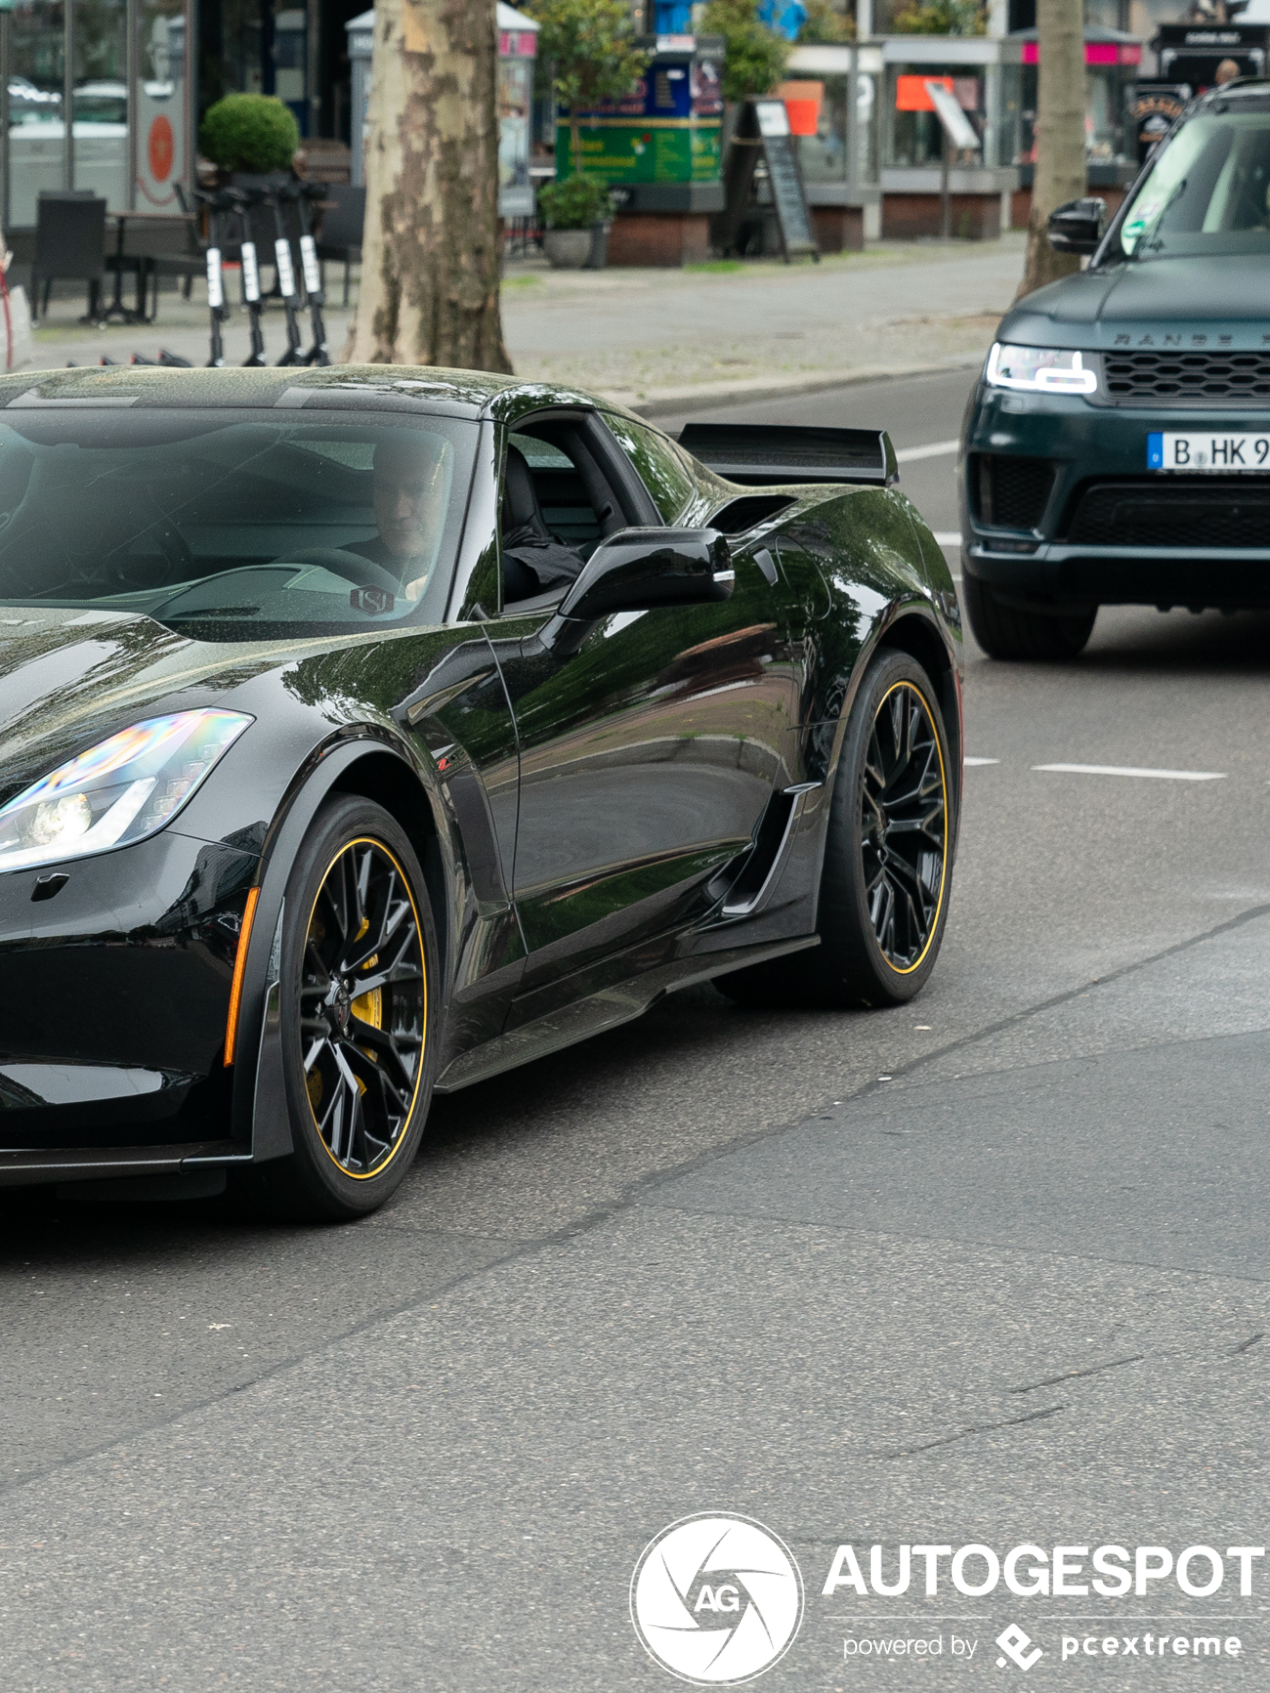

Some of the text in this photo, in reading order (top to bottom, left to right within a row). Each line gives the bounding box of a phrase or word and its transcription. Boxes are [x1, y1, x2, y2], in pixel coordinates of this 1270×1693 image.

[1114, 333, 1233, 346] RANGE
[1174, 439, 1191, 465] B
[1212, 439, 1246, 465] HK
